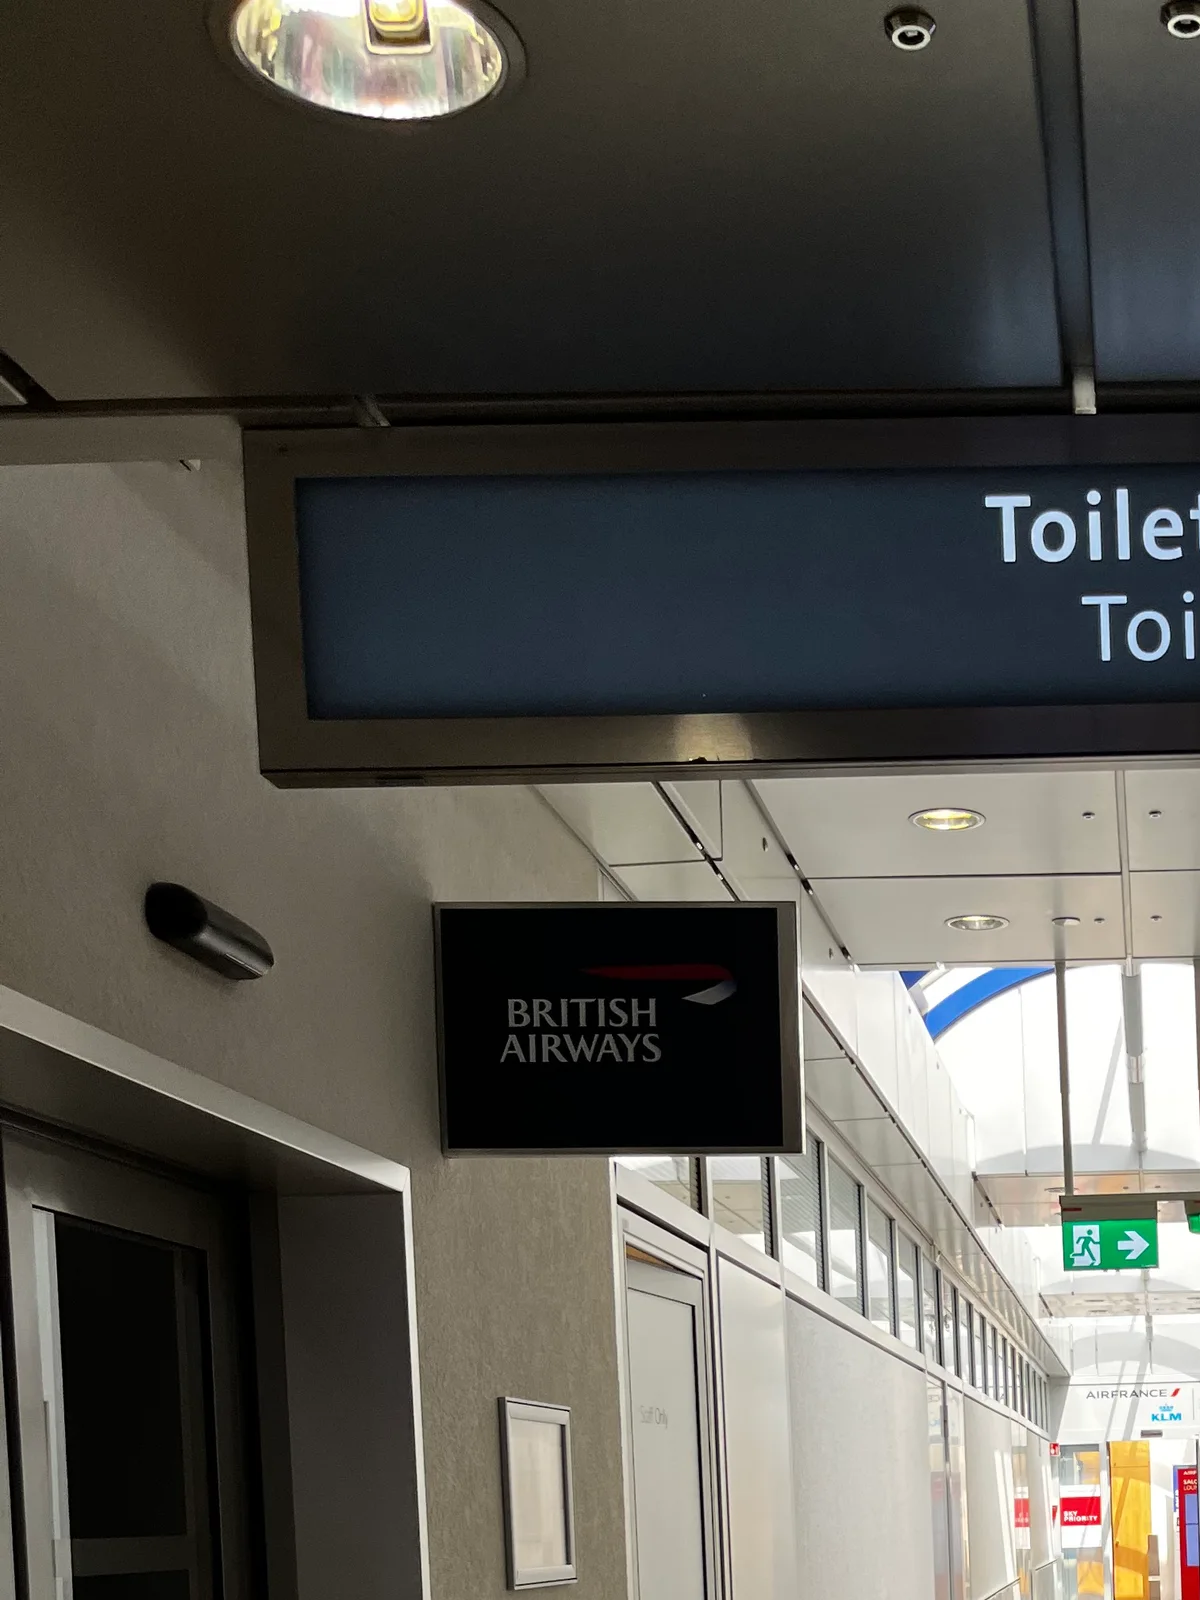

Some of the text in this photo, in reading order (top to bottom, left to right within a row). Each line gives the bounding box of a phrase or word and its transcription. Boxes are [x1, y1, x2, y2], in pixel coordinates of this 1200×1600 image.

[507, 998, 657, 1028] BRITISH
[500, 1033, 662, 1063] AIRWAYS
[1151, 1412, 1182, 1422] KLM
